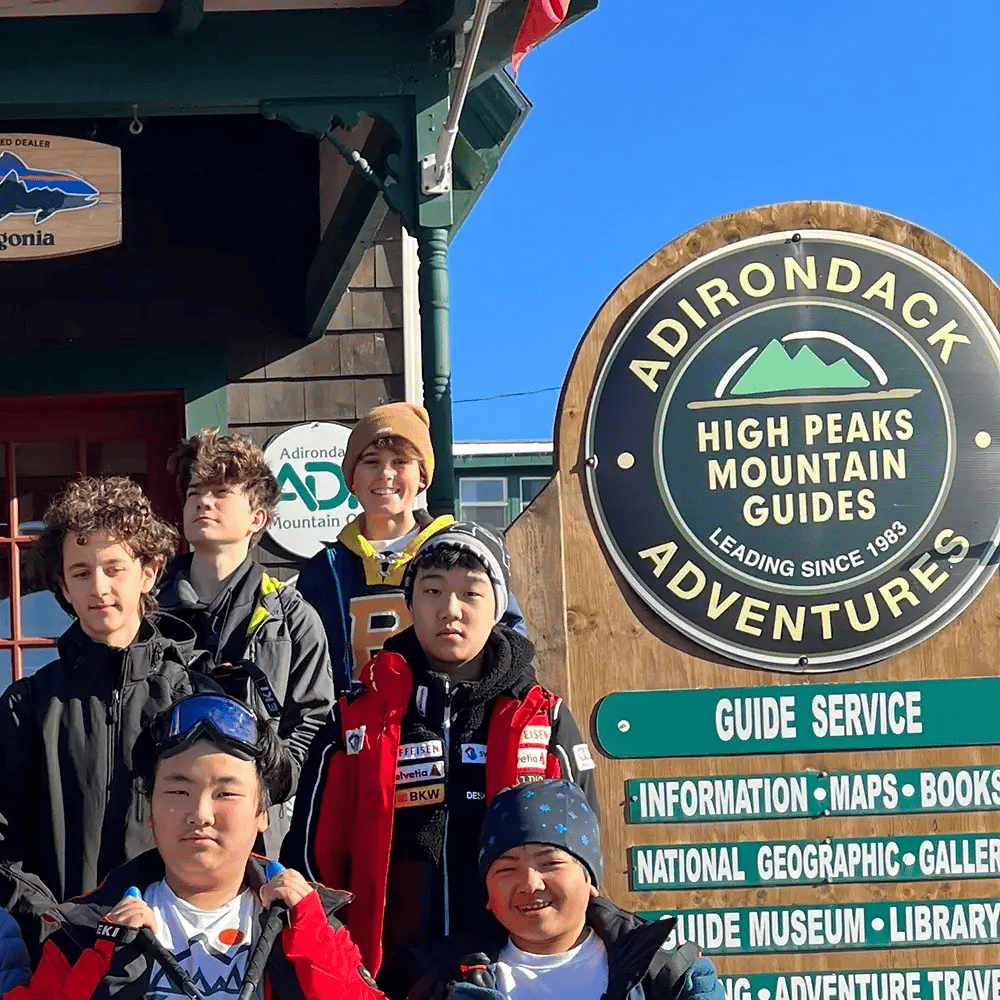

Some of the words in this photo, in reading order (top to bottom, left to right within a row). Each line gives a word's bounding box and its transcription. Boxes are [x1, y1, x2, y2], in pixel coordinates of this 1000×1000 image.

[15, 138, 51, 149] DEALER
[628, 256, 972, 393] ADIRONDACK
[697, 416, 790, 453] HIGH
[804, 409, 915, 447] PEAKS
[708, 448, 907, 492] MOUNTAIN
[742, 488, 876, 528] GUIDES
[708, 526, 796, 578] LEADING
[800, 549, 865, 579] SINCE
[865, 519, 909, 559] 1983
[638, 528, 971, 643] ADVENTURES
[714, 696, 797, 742] GUIDE
[811, 690, 924, 738] SERVICE
[409, 788, 440, 802] BKW
[639, 776, 808, 818] INFORMATION
[830, 772, 899, 811] MAPS
[637, 846, 745, 884] NATIONAL
[756, 840, 901, 881] GEOGRAPHIC
[749, 907, 866, 947] MUSEUM
[889, 902, 1000, 942] LIBRARY
